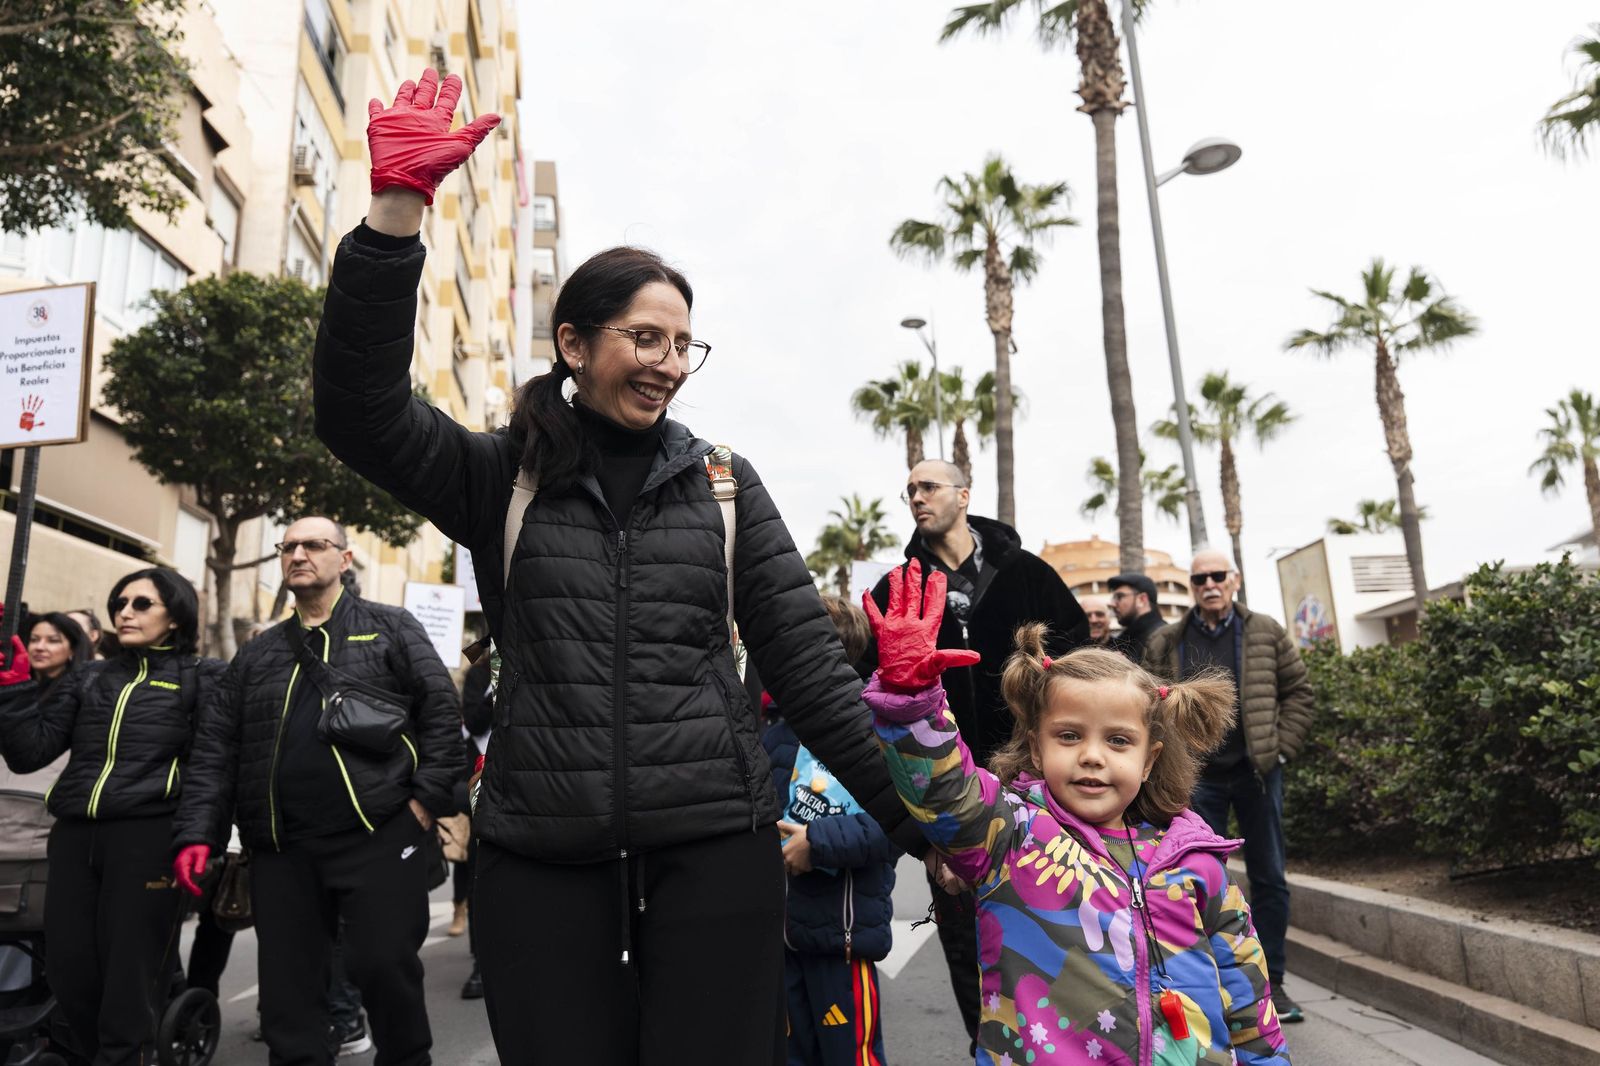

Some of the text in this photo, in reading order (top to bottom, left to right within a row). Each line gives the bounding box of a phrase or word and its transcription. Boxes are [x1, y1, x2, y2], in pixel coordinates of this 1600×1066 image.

[15, 334, 60, 345] Impuestos
[0, 346, 66, 361] Proporcionales
[6, 360, 65, 374] los Beneficios
[20, 376, 49, 386] Reales
